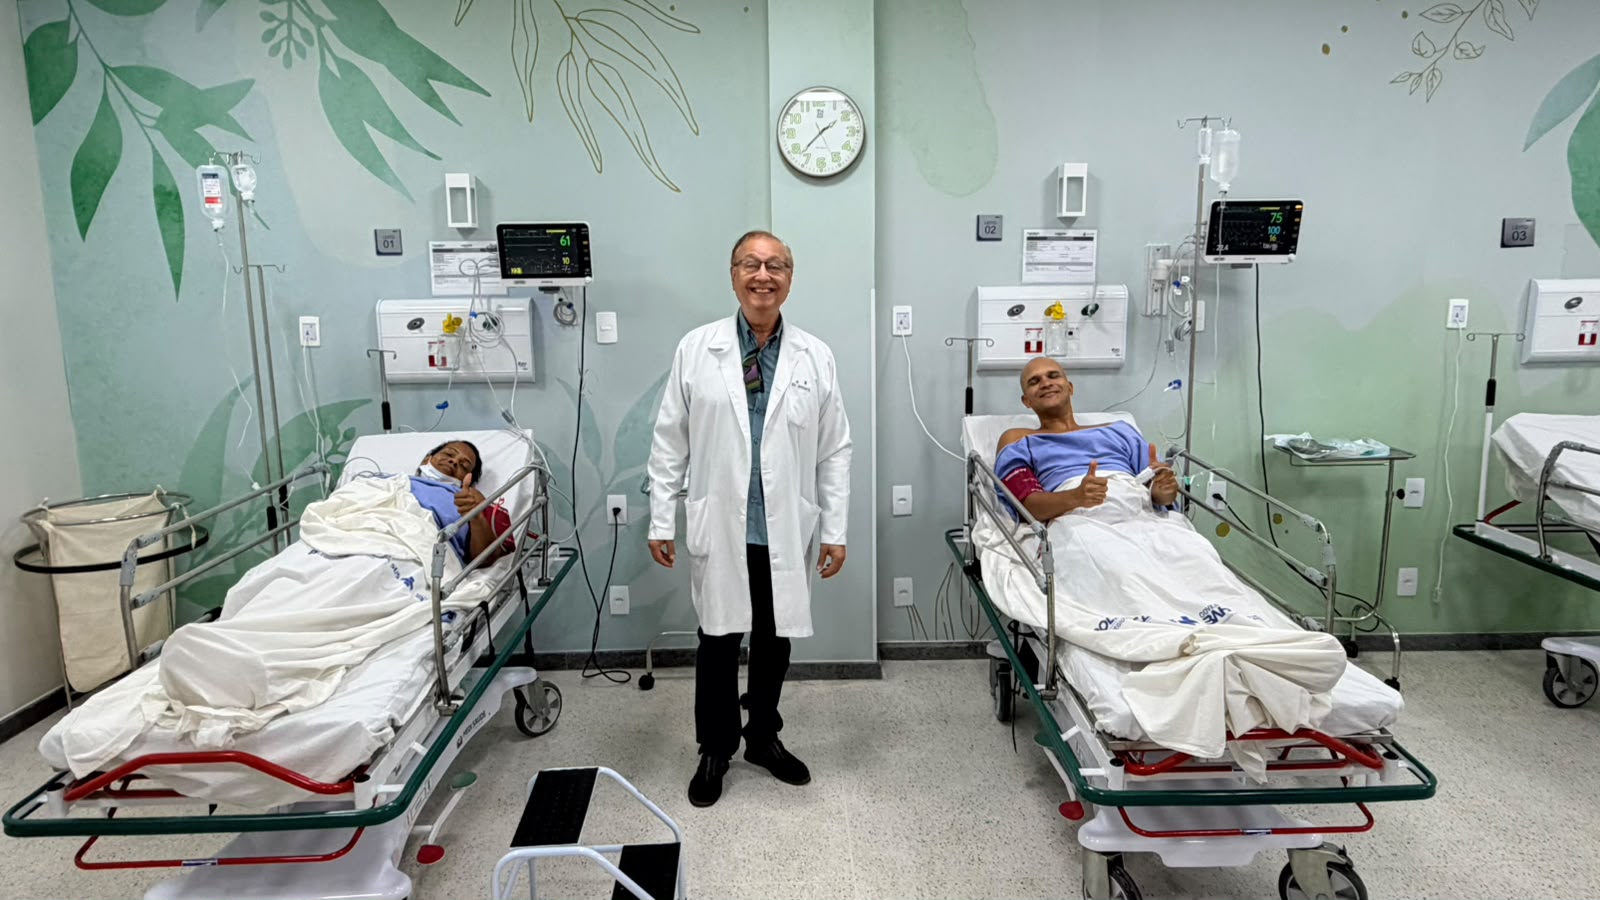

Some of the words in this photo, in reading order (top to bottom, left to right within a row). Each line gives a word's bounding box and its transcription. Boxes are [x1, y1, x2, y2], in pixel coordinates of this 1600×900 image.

[789, 113, 802, 125] 10
[803, 153, 812, 165] 7
[1270, 212, 1283, 224] 75
[984, 225, 997, 235] 02
[1267, 225, 1281, 235] 100
[1511, 230, 1527, 241] 03
[383, 239, 394, 249] 01
[560, 235, 571, 247] 61
[562, 256, 570, 265] 10
